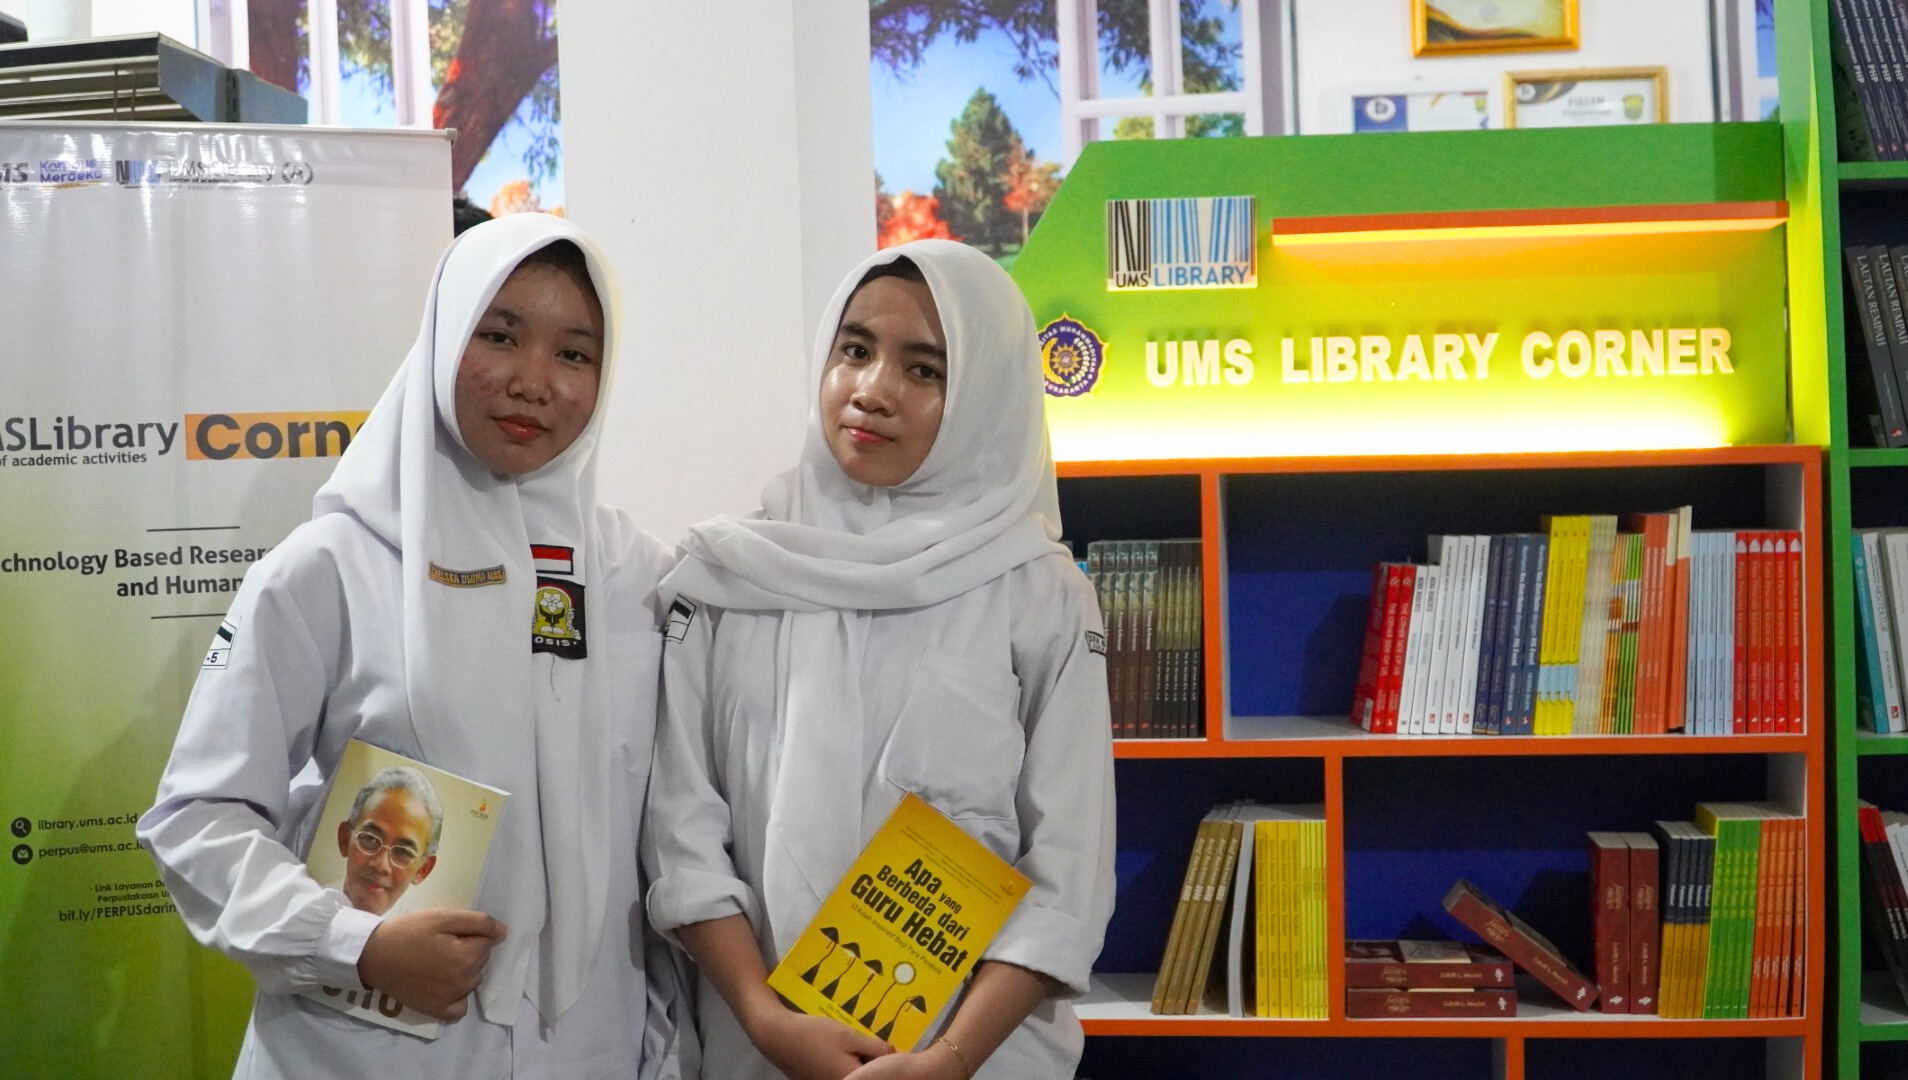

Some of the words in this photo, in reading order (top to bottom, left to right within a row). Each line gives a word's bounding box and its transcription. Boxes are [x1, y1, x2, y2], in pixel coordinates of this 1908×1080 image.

[1854, 64, 1864, 83] PHP
[1868, 64, 1878, 83] PHP
[1881, 64, 1891, 83] PHP
[1893, 64, 1904, 83] PHP
[1115, 272, 1149, 288] UMS
[1154, 264, 1250, 287] LIBRARY
[1857, 255, 1876, 300] LAUTAN
[1868, 302, 1887, 346] REMPAH
[1879, 254, 1898, 298] LAUTAN
[1890, 300, 1908, 345] REMPAH
[1145, 339, 1254, 387] UMS
[1281, 332, 1499, 384] LIBRARY
[1521, 327, 1735, 380] CORNER
[0, 415, 179, 456] SLibrary
[195, 413, 365, 460] Corn
[12, 452, 78, 467] academic
[82, 450, 148, 465] activities
[0, 551, 108, 576] chnology
[115, 546, 183, 568] Based
[116, 576, 159, 597] and
[166, 575, 244, 595] Human
[534, 636, 571, 647] OSIS
[38, 813, 138, 831] library.ums.ac.id
[95, 884, 112, 893] Link
[115, 882, 153, 893] Layanan
[903, 858, 942, 896] Apa
[938, 891, 962, 914] yang
[98, 892, 159, 904] Perpustakaan
[876, 864, 937, 916] Berbeda
[937, 912, 970, 942] dari
[59, 903, 181, 922] bit.ly/PERPUSdarin
[850, 873, 904, 925] Guru
[900, 912, 969, 973] Hebat
